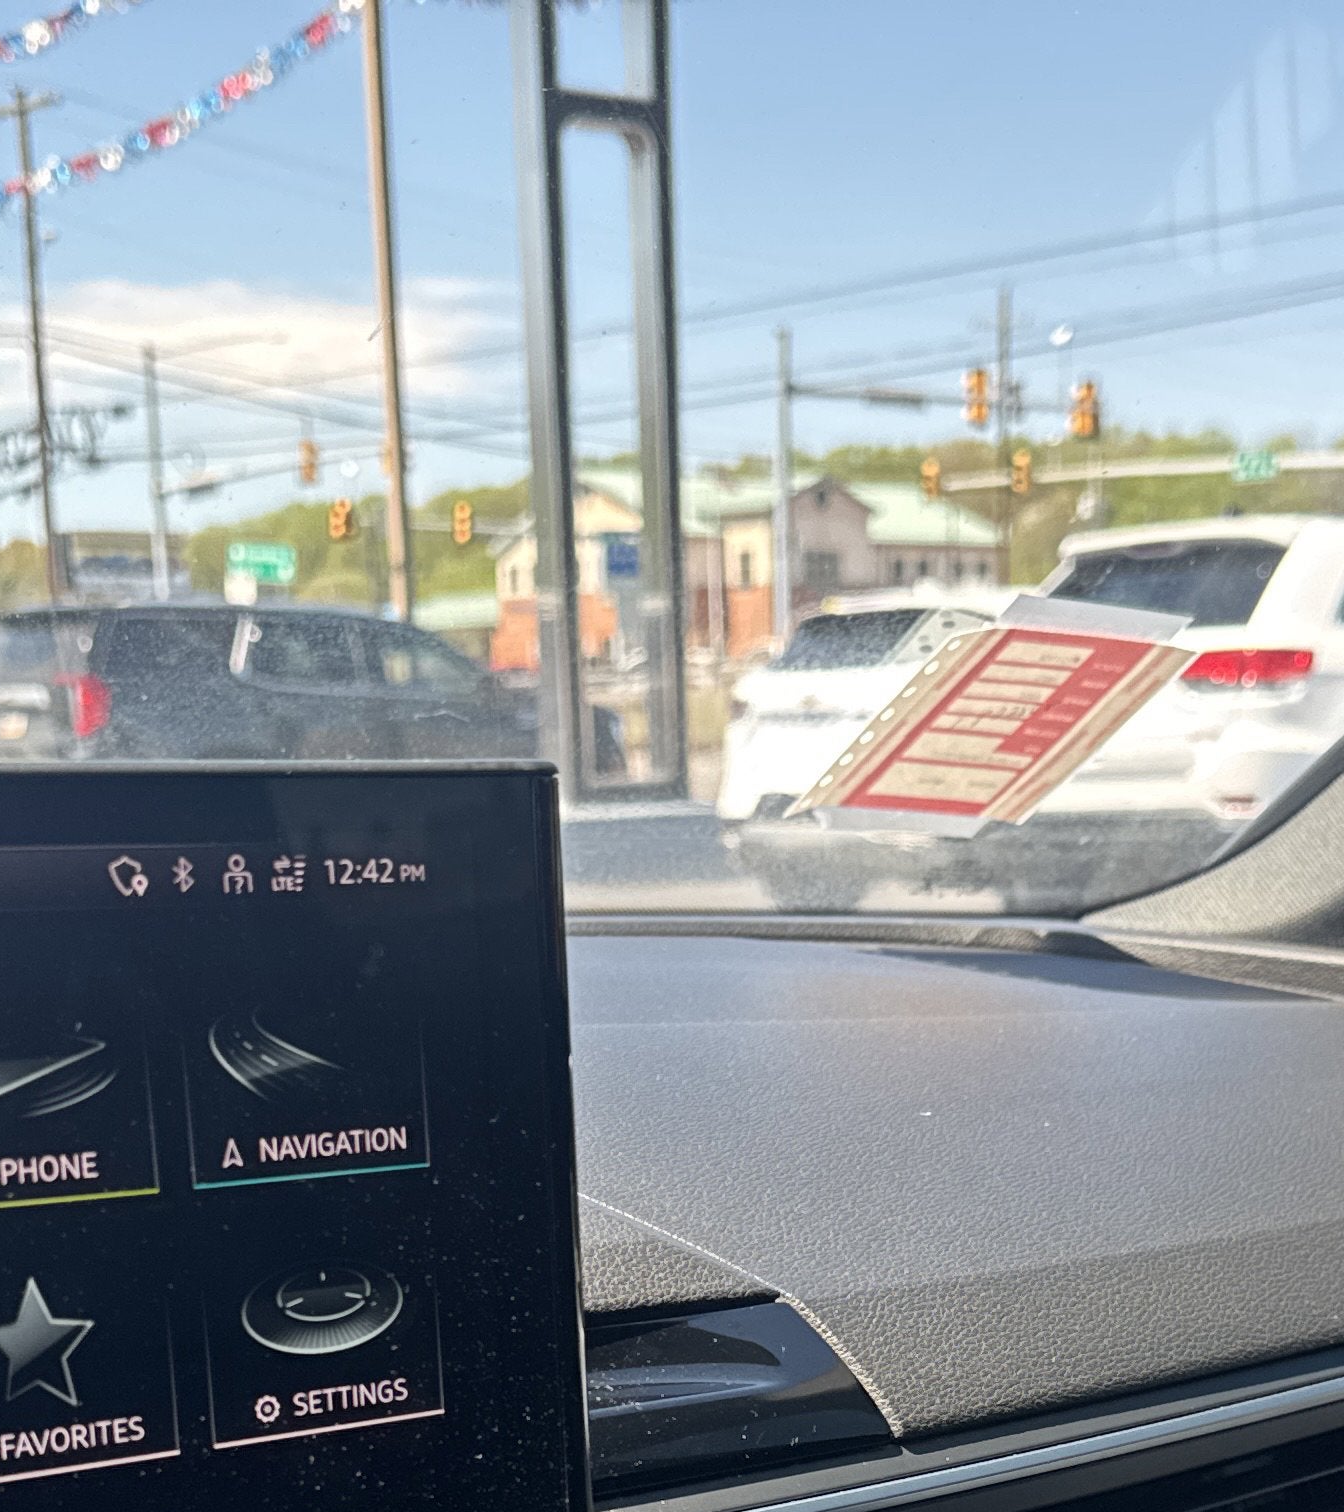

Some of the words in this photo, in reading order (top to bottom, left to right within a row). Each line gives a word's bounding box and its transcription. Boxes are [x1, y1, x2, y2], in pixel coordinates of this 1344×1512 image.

[323, 857, 395, 887] 12:42
[399, 863, 427, 884] PM
[258, 1126, 408, 1165] NAVIGATION
[291, 1377, 410, 1418] SETTINGS
